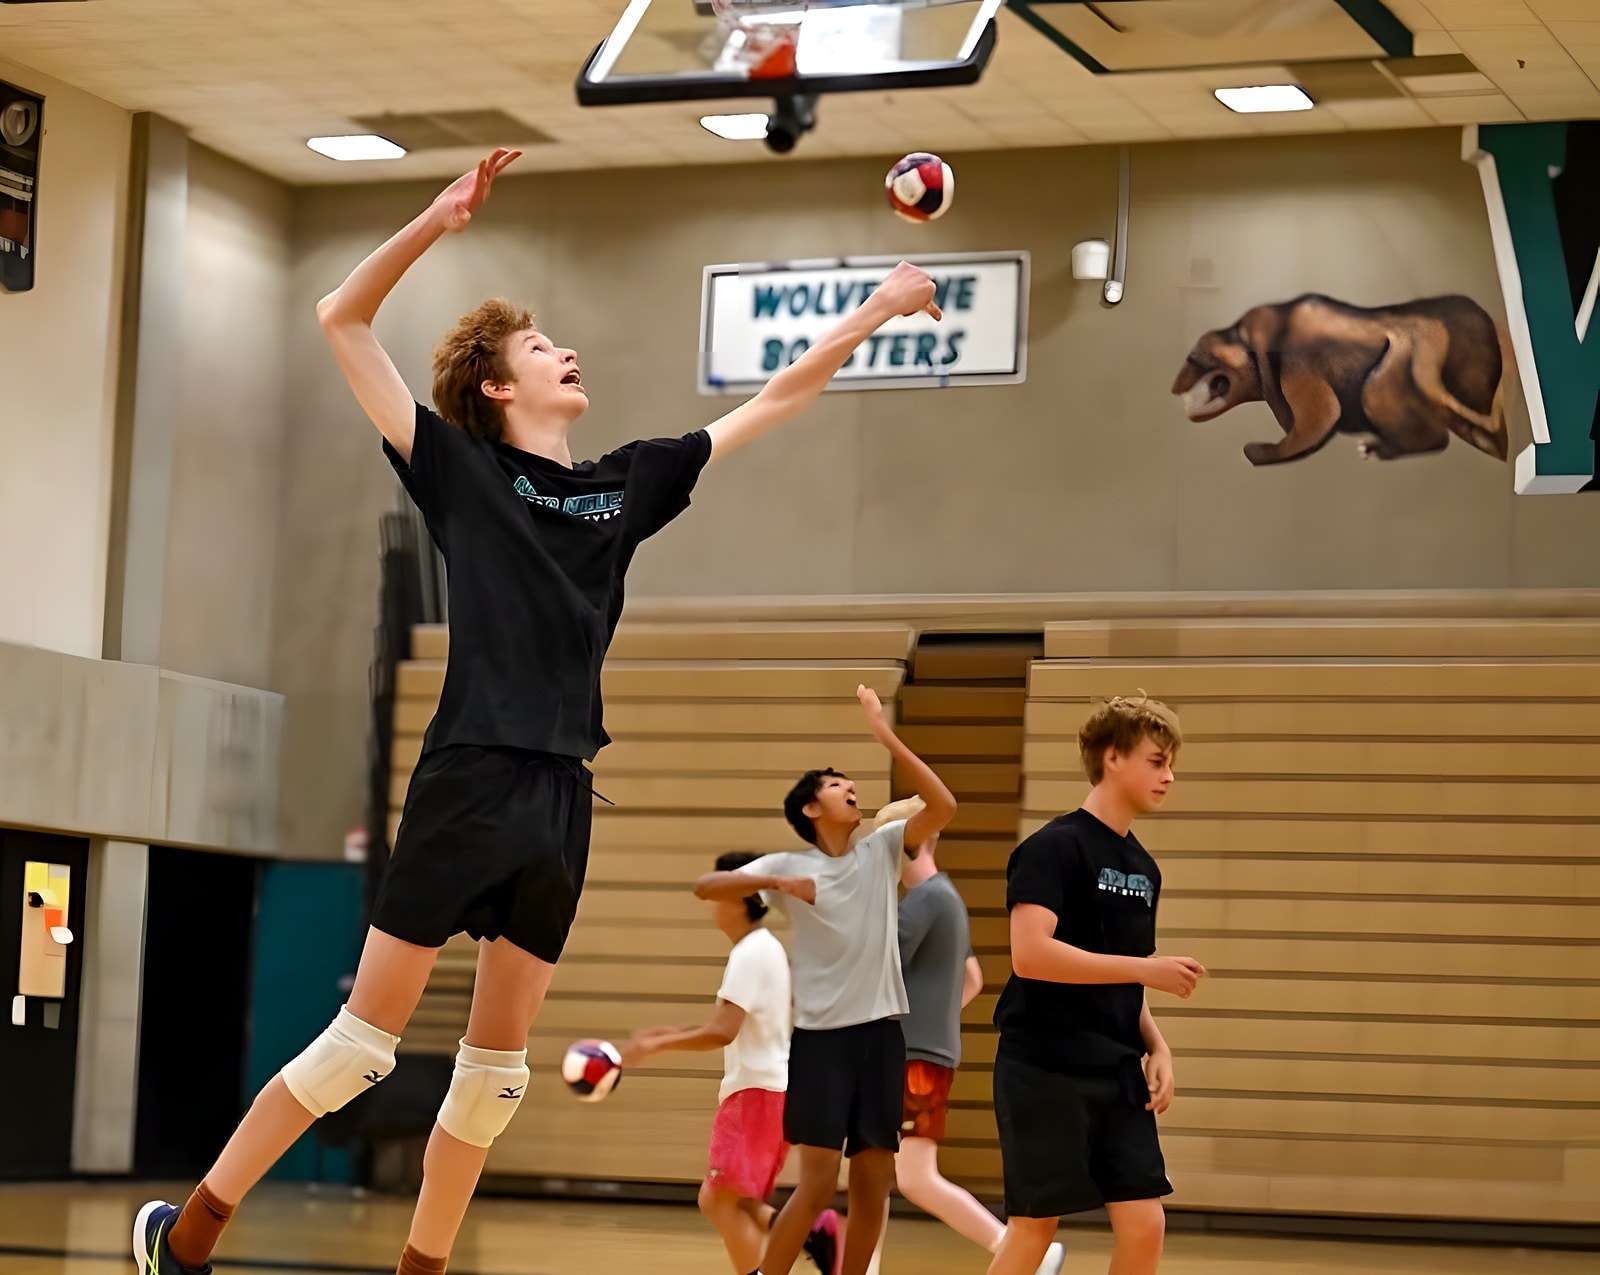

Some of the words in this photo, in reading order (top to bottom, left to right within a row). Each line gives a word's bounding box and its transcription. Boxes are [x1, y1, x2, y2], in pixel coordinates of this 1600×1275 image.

[753, 277, 978, 318] WOLVENE
[763, 331, 966, 371] BOTERS
[563, 491, 624, 515] NIGUE
